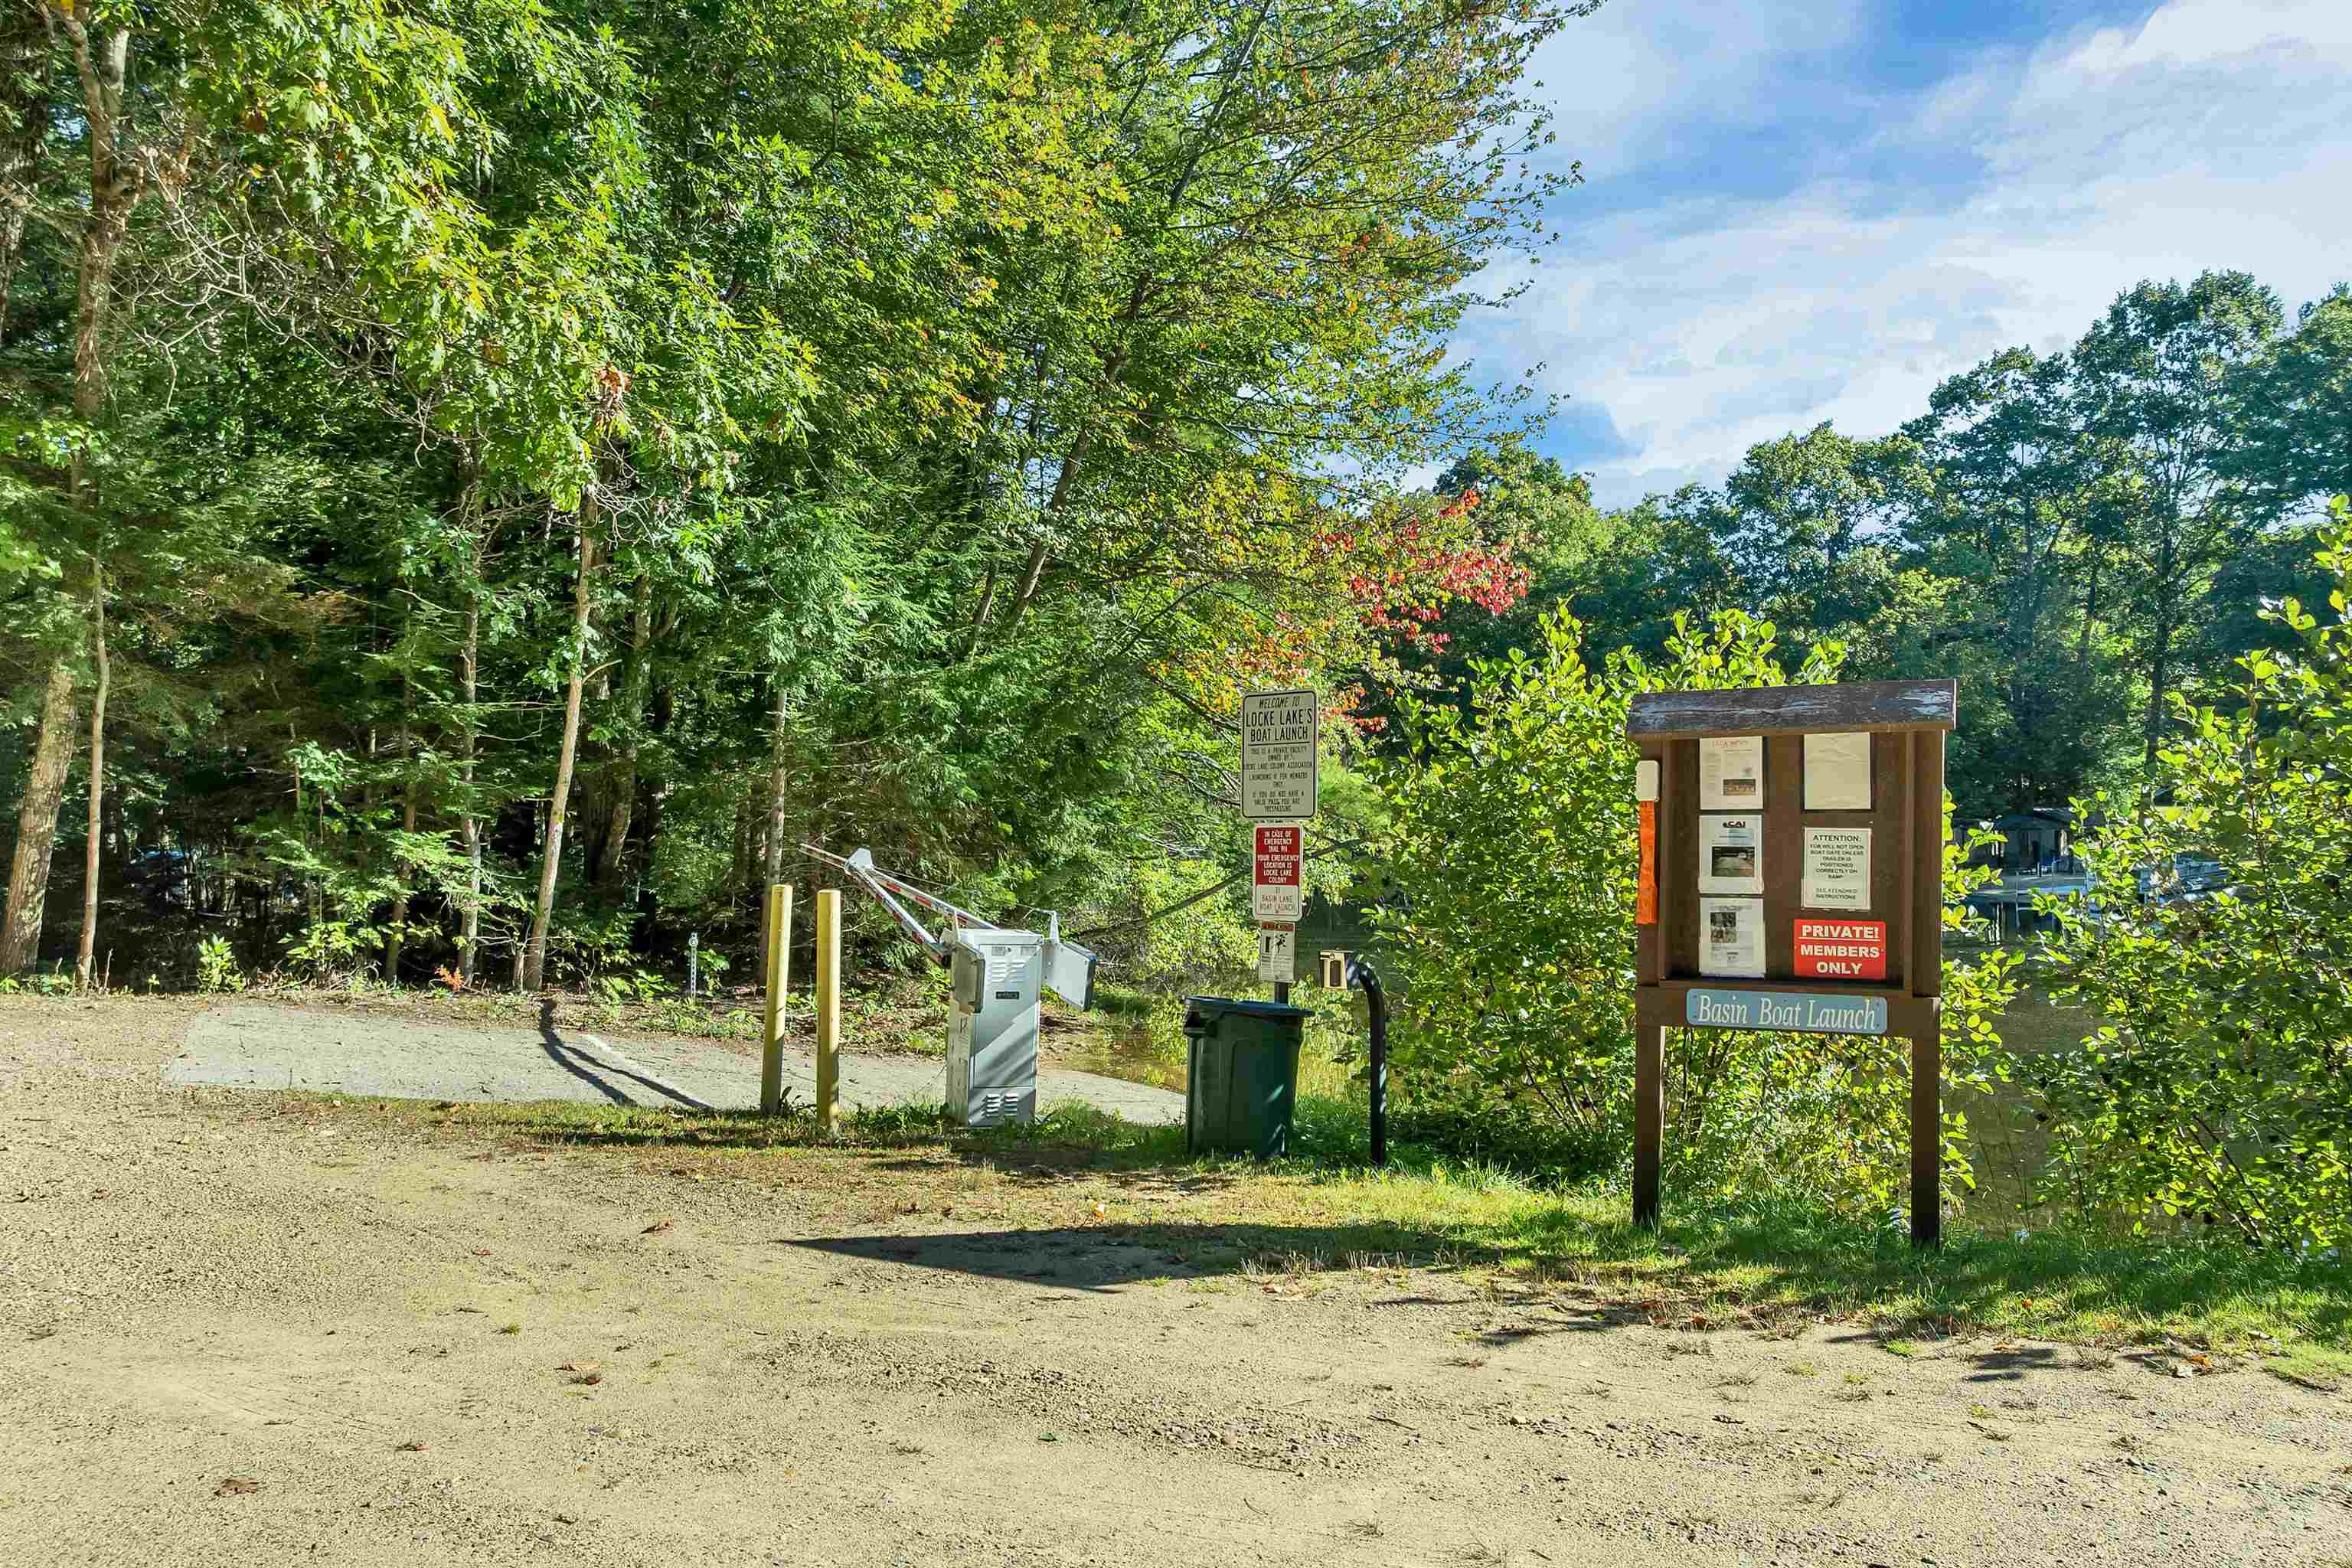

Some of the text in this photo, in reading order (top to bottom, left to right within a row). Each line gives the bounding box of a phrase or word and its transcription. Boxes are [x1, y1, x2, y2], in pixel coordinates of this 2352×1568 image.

[1259, 696, 1300, 709] WELCOME TO
[1246, 708, 1312, 727] LOCKE LAKE'S
[1250, 726, 1308, 742] BOAT LAUNCH
[1802, 924, 1880, 939] PRIVATE!
[1800, 943, 1880, 959] MEMBERS
[1816, 961, 1863, 975] ONLY
[1697, 994, 1876, 1030] Basin Boat Launch
